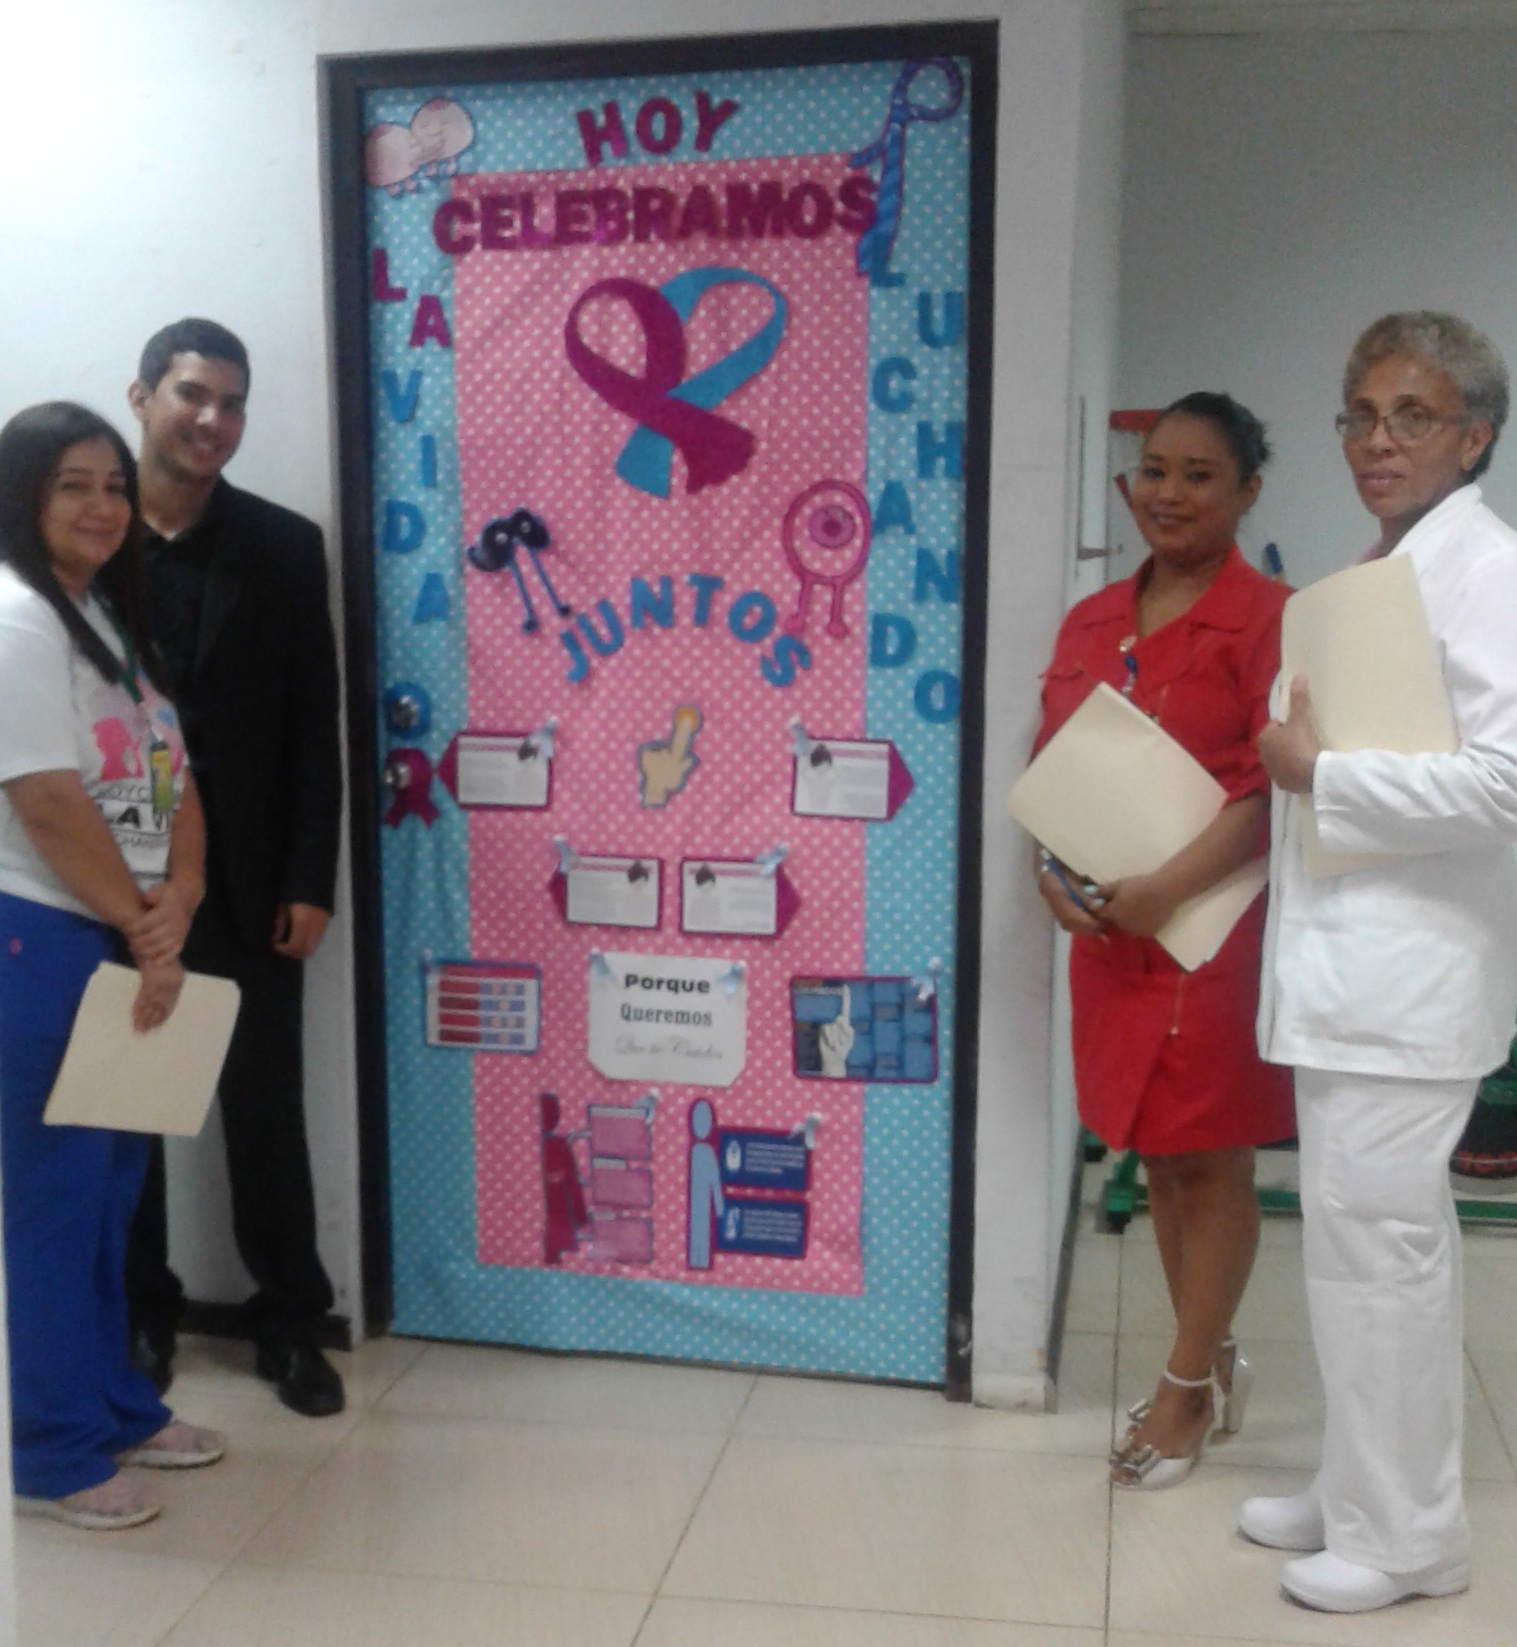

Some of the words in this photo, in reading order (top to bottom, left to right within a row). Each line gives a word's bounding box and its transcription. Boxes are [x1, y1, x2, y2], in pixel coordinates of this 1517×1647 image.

[576, 90, 740, 166] HOY
[433, 176, 880, 255] CELEBRAMOS
[373, 248, 451, 347] LA
[380, 369, 450, 625] VIDA
[560, 574, 812, 687] JUNTOS
[620, 1003, 713, 1026] Queremos
[625, 973, 711, 994] Porque
